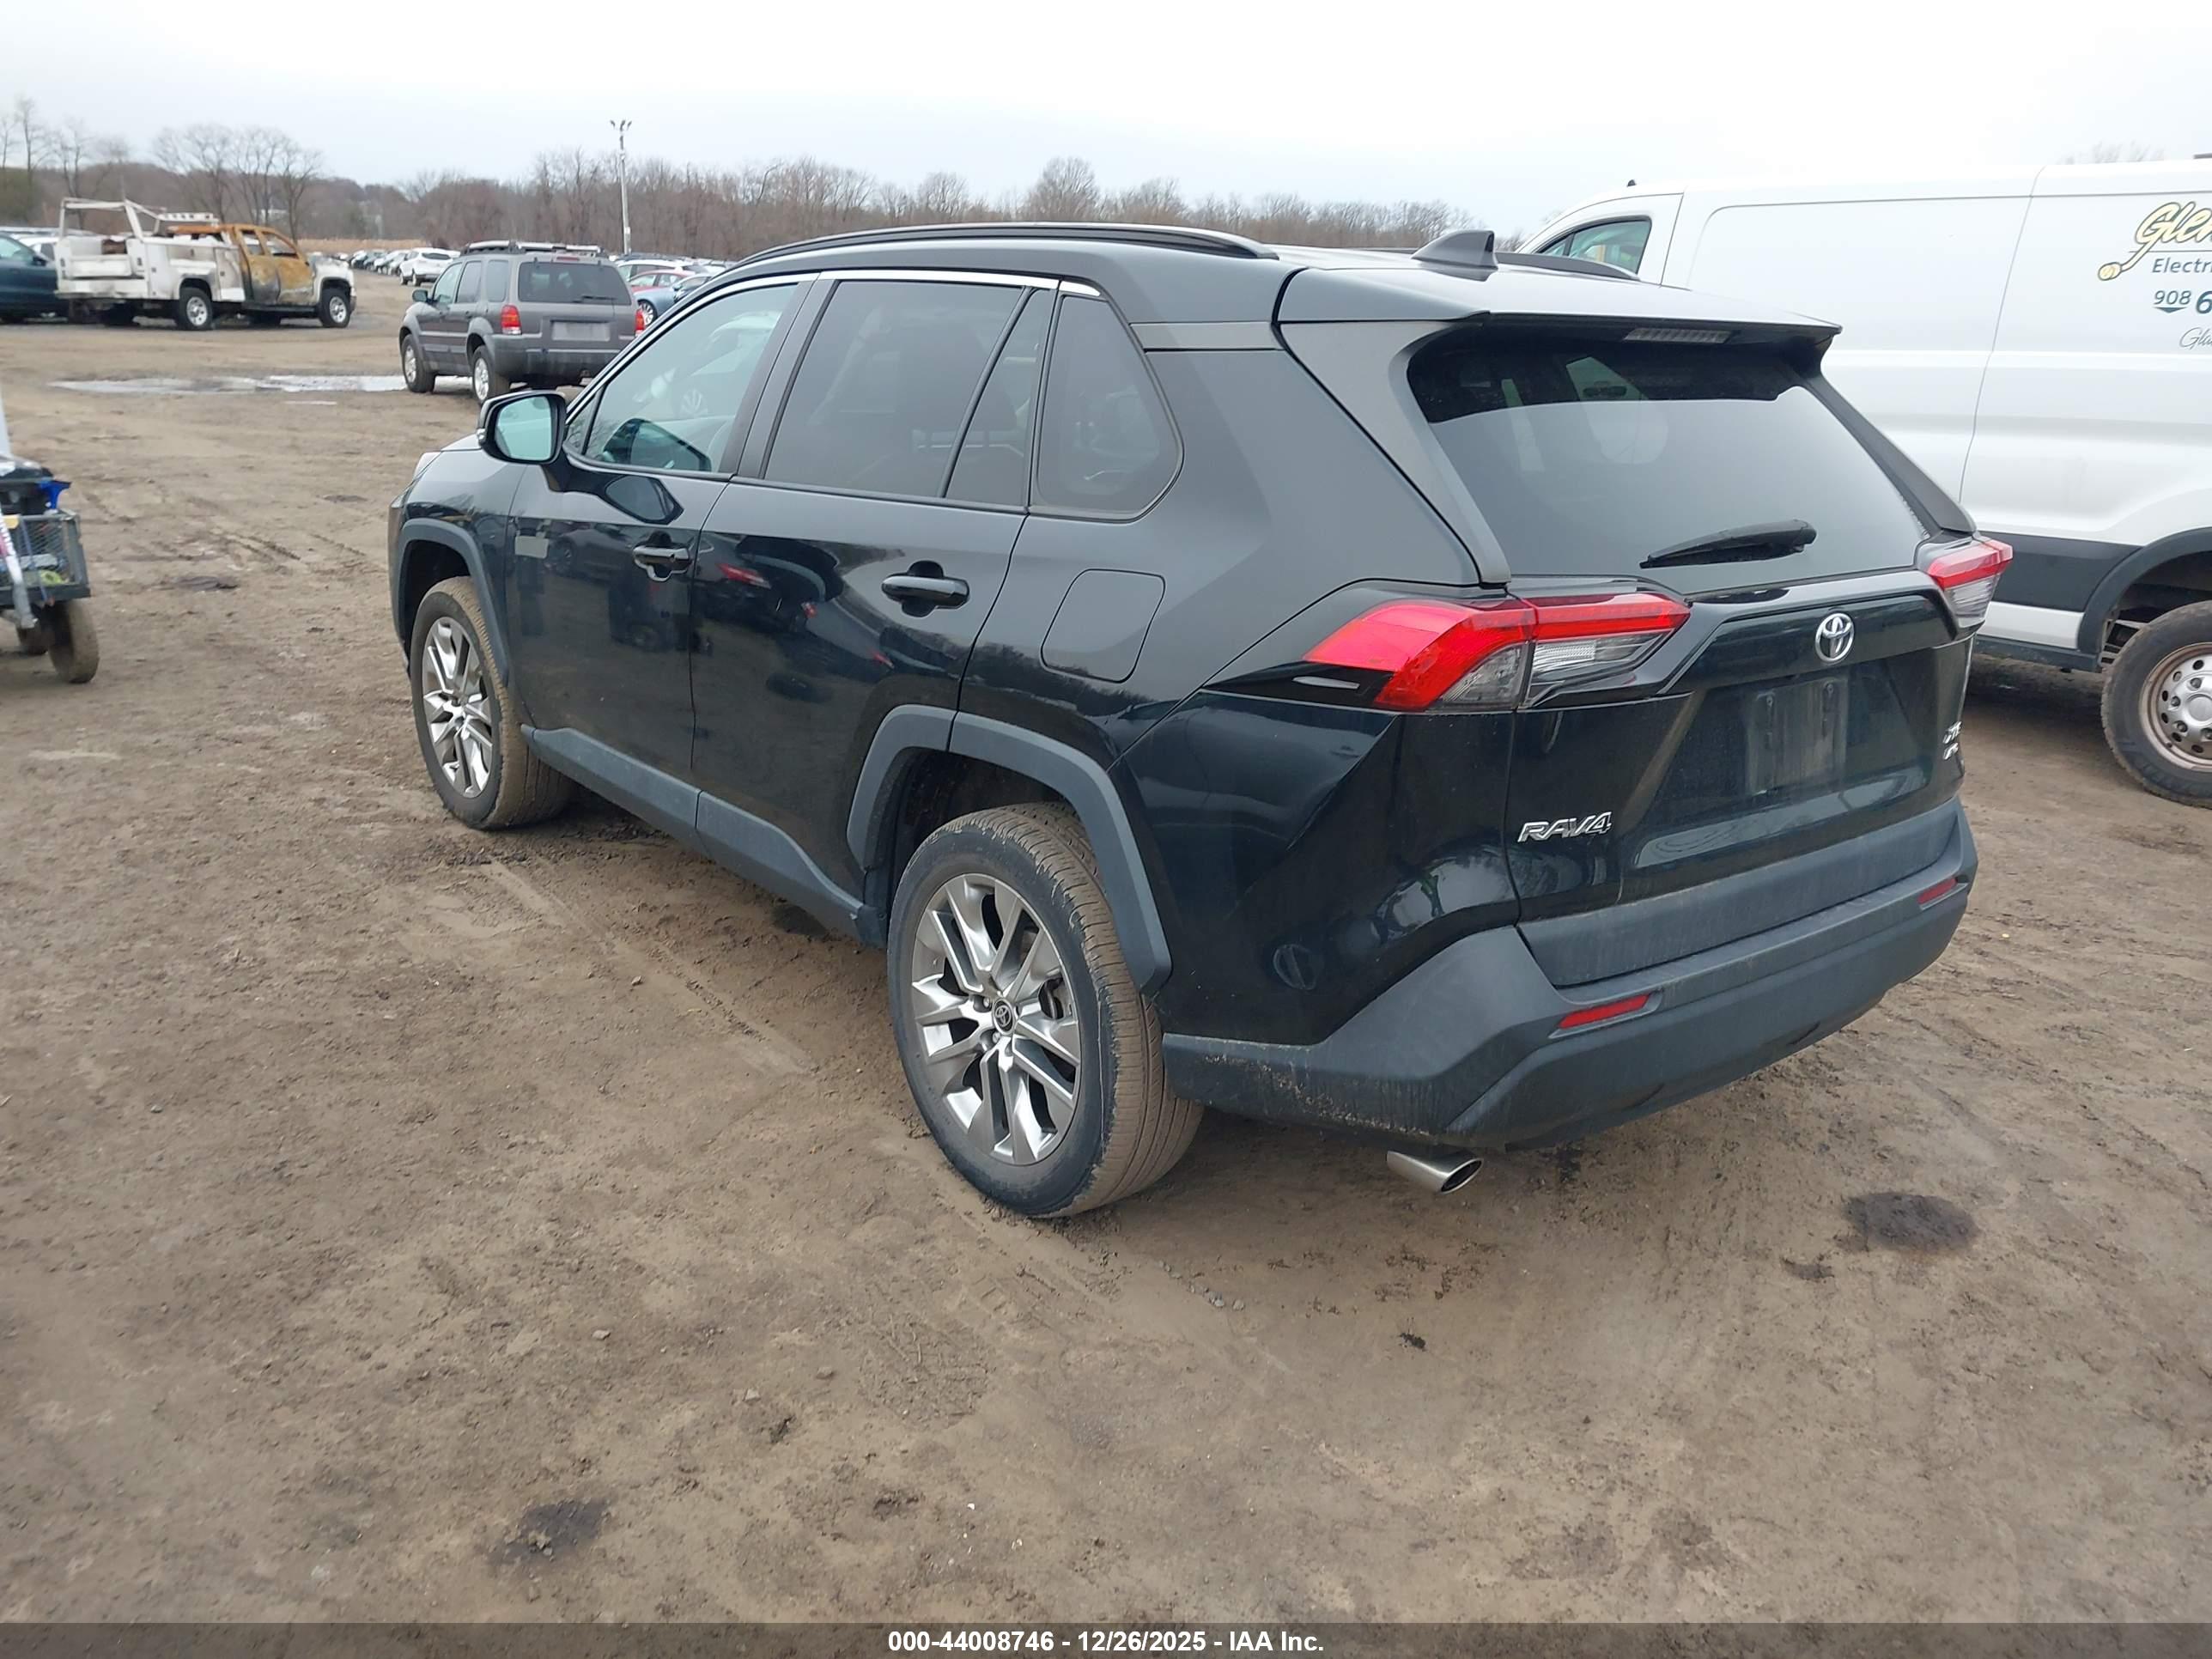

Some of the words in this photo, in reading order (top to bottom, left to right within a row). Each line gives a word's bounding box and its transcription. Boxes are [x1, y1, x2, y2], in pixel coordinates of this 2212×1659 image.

[2151, 256, 2212, 274] Electr
[2153, 289, 2192, 306] 908
[1516, 811, 1613, 843] RAV4
